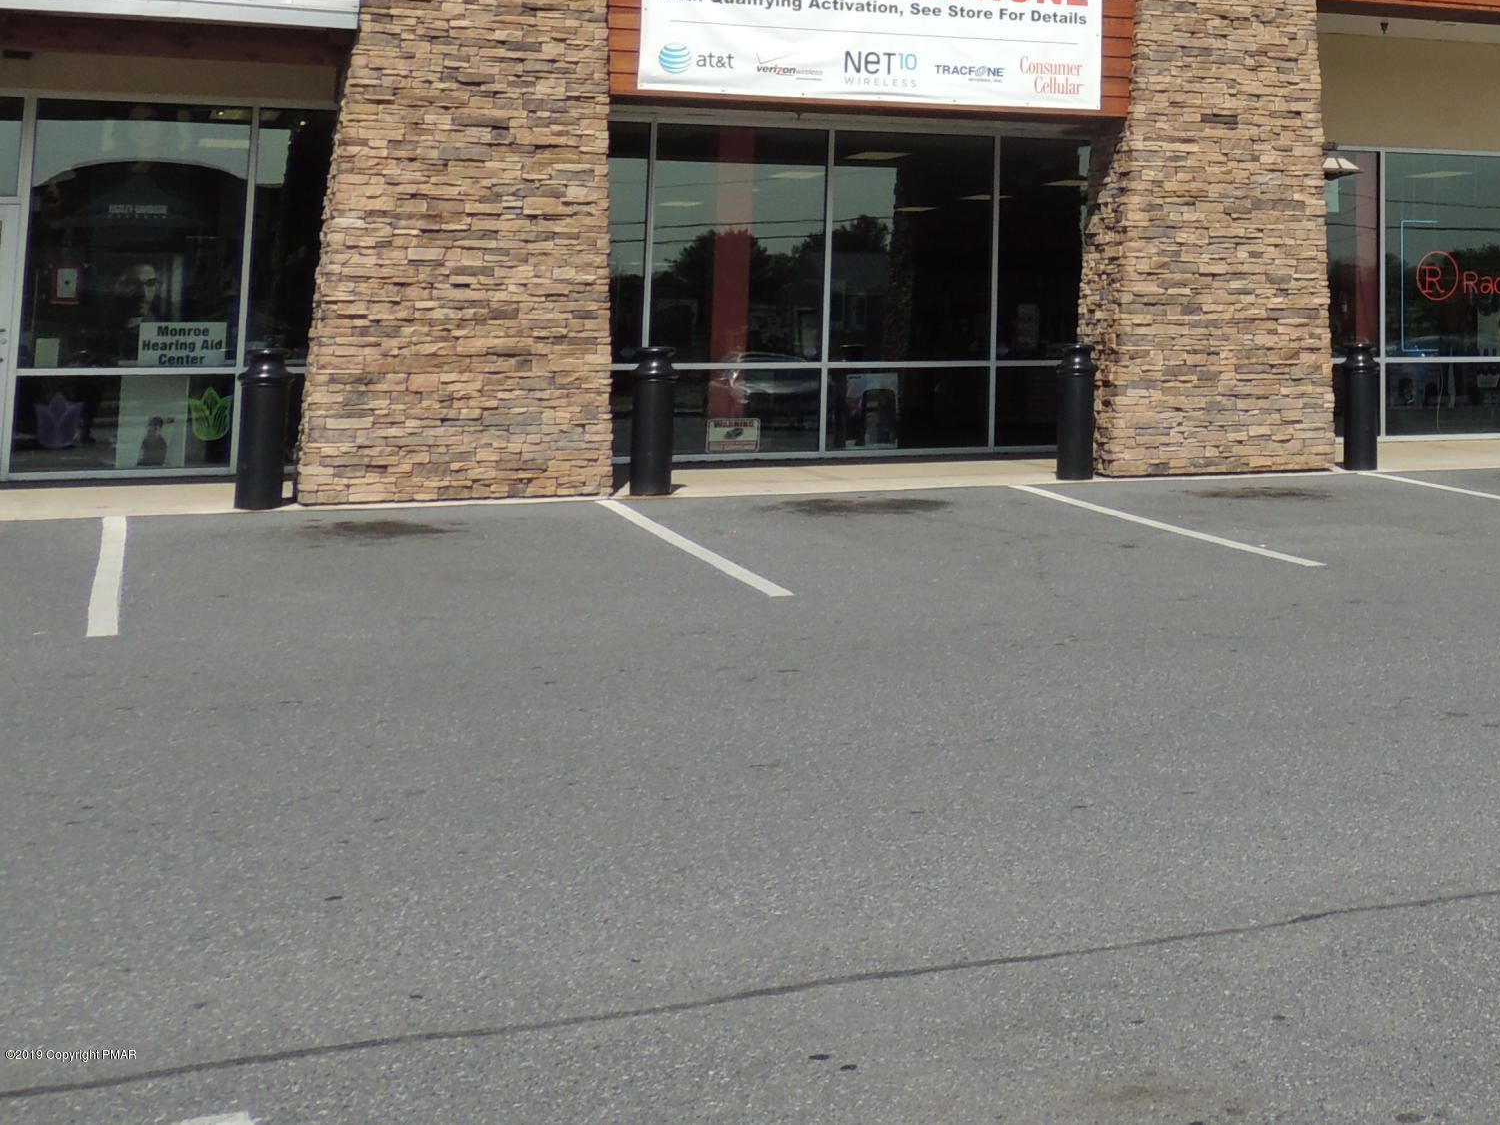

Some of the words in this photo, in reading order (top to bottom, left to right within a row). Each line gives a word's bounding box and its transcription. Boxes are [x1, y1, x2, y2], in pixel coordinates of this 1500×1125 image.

[909, 2, 943, 17] See
[947, 4, 994, 21] Store
[998, 7, 1026, 22] For
[1030, 9, 1089, 26] Details
[695, 51, 736, 71] at&t
[1019, 54, 1083, 78] Consumer
[756, 63, 797, 77] verizon
[934, 63, 1006, 79] TRACFONE
[843, 75, 918, 89] WIRELESS
[1033, 75, 1084, 97] Cellular
[157, 325, 210, 337] Monroe
[142, 339, 197, 353] Hearing
[201, 339, 223, 351] Aid
[158, 353, 206, 365] Center
